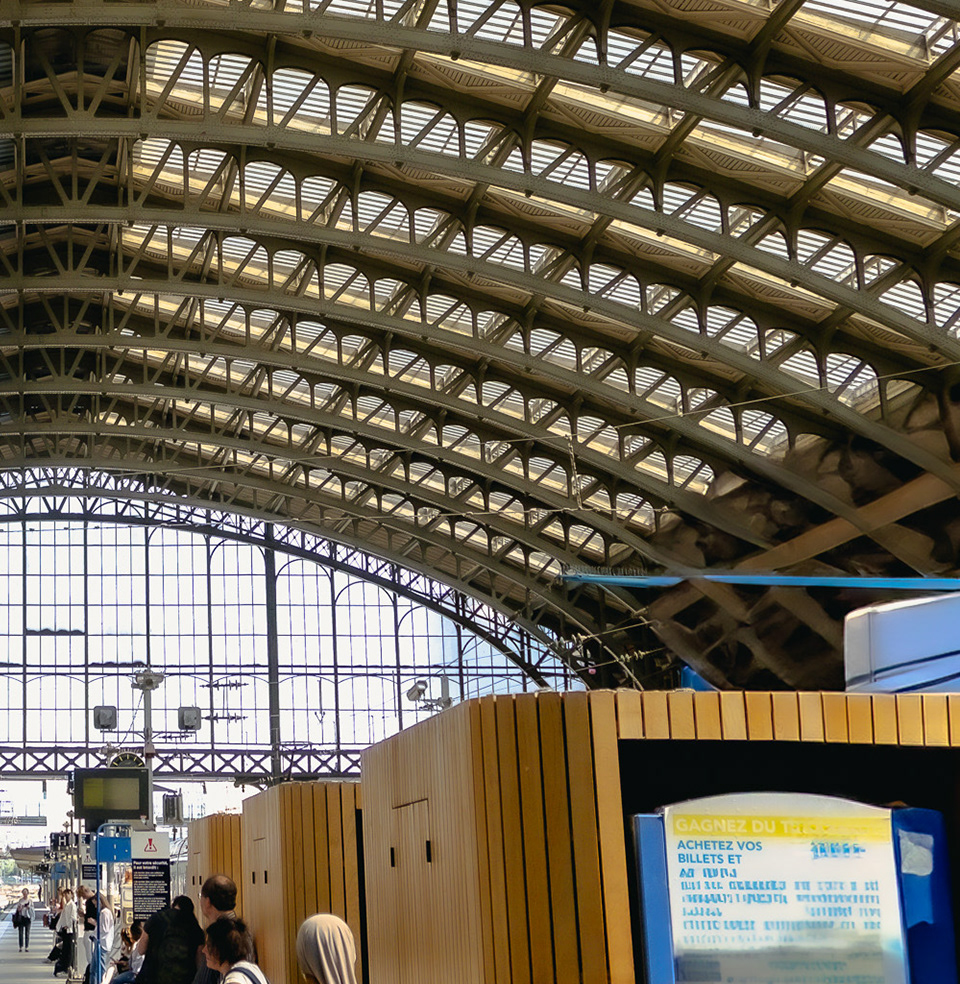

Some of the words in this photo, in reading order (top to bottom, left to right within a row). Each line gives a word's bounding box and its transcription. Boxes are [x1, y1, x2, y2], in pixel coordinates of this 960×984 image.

[675, 818, 747, 833] GAGNEZ
[751, 820, 776, 833] DU
[58, 836, 67, 846] H
[677, 840, 734, 851] ACHETEZ
[736, 841, 763, 852] VOS
[678, 853, 724, 864] BILLETS
[728, 854, 742, 864] ET
